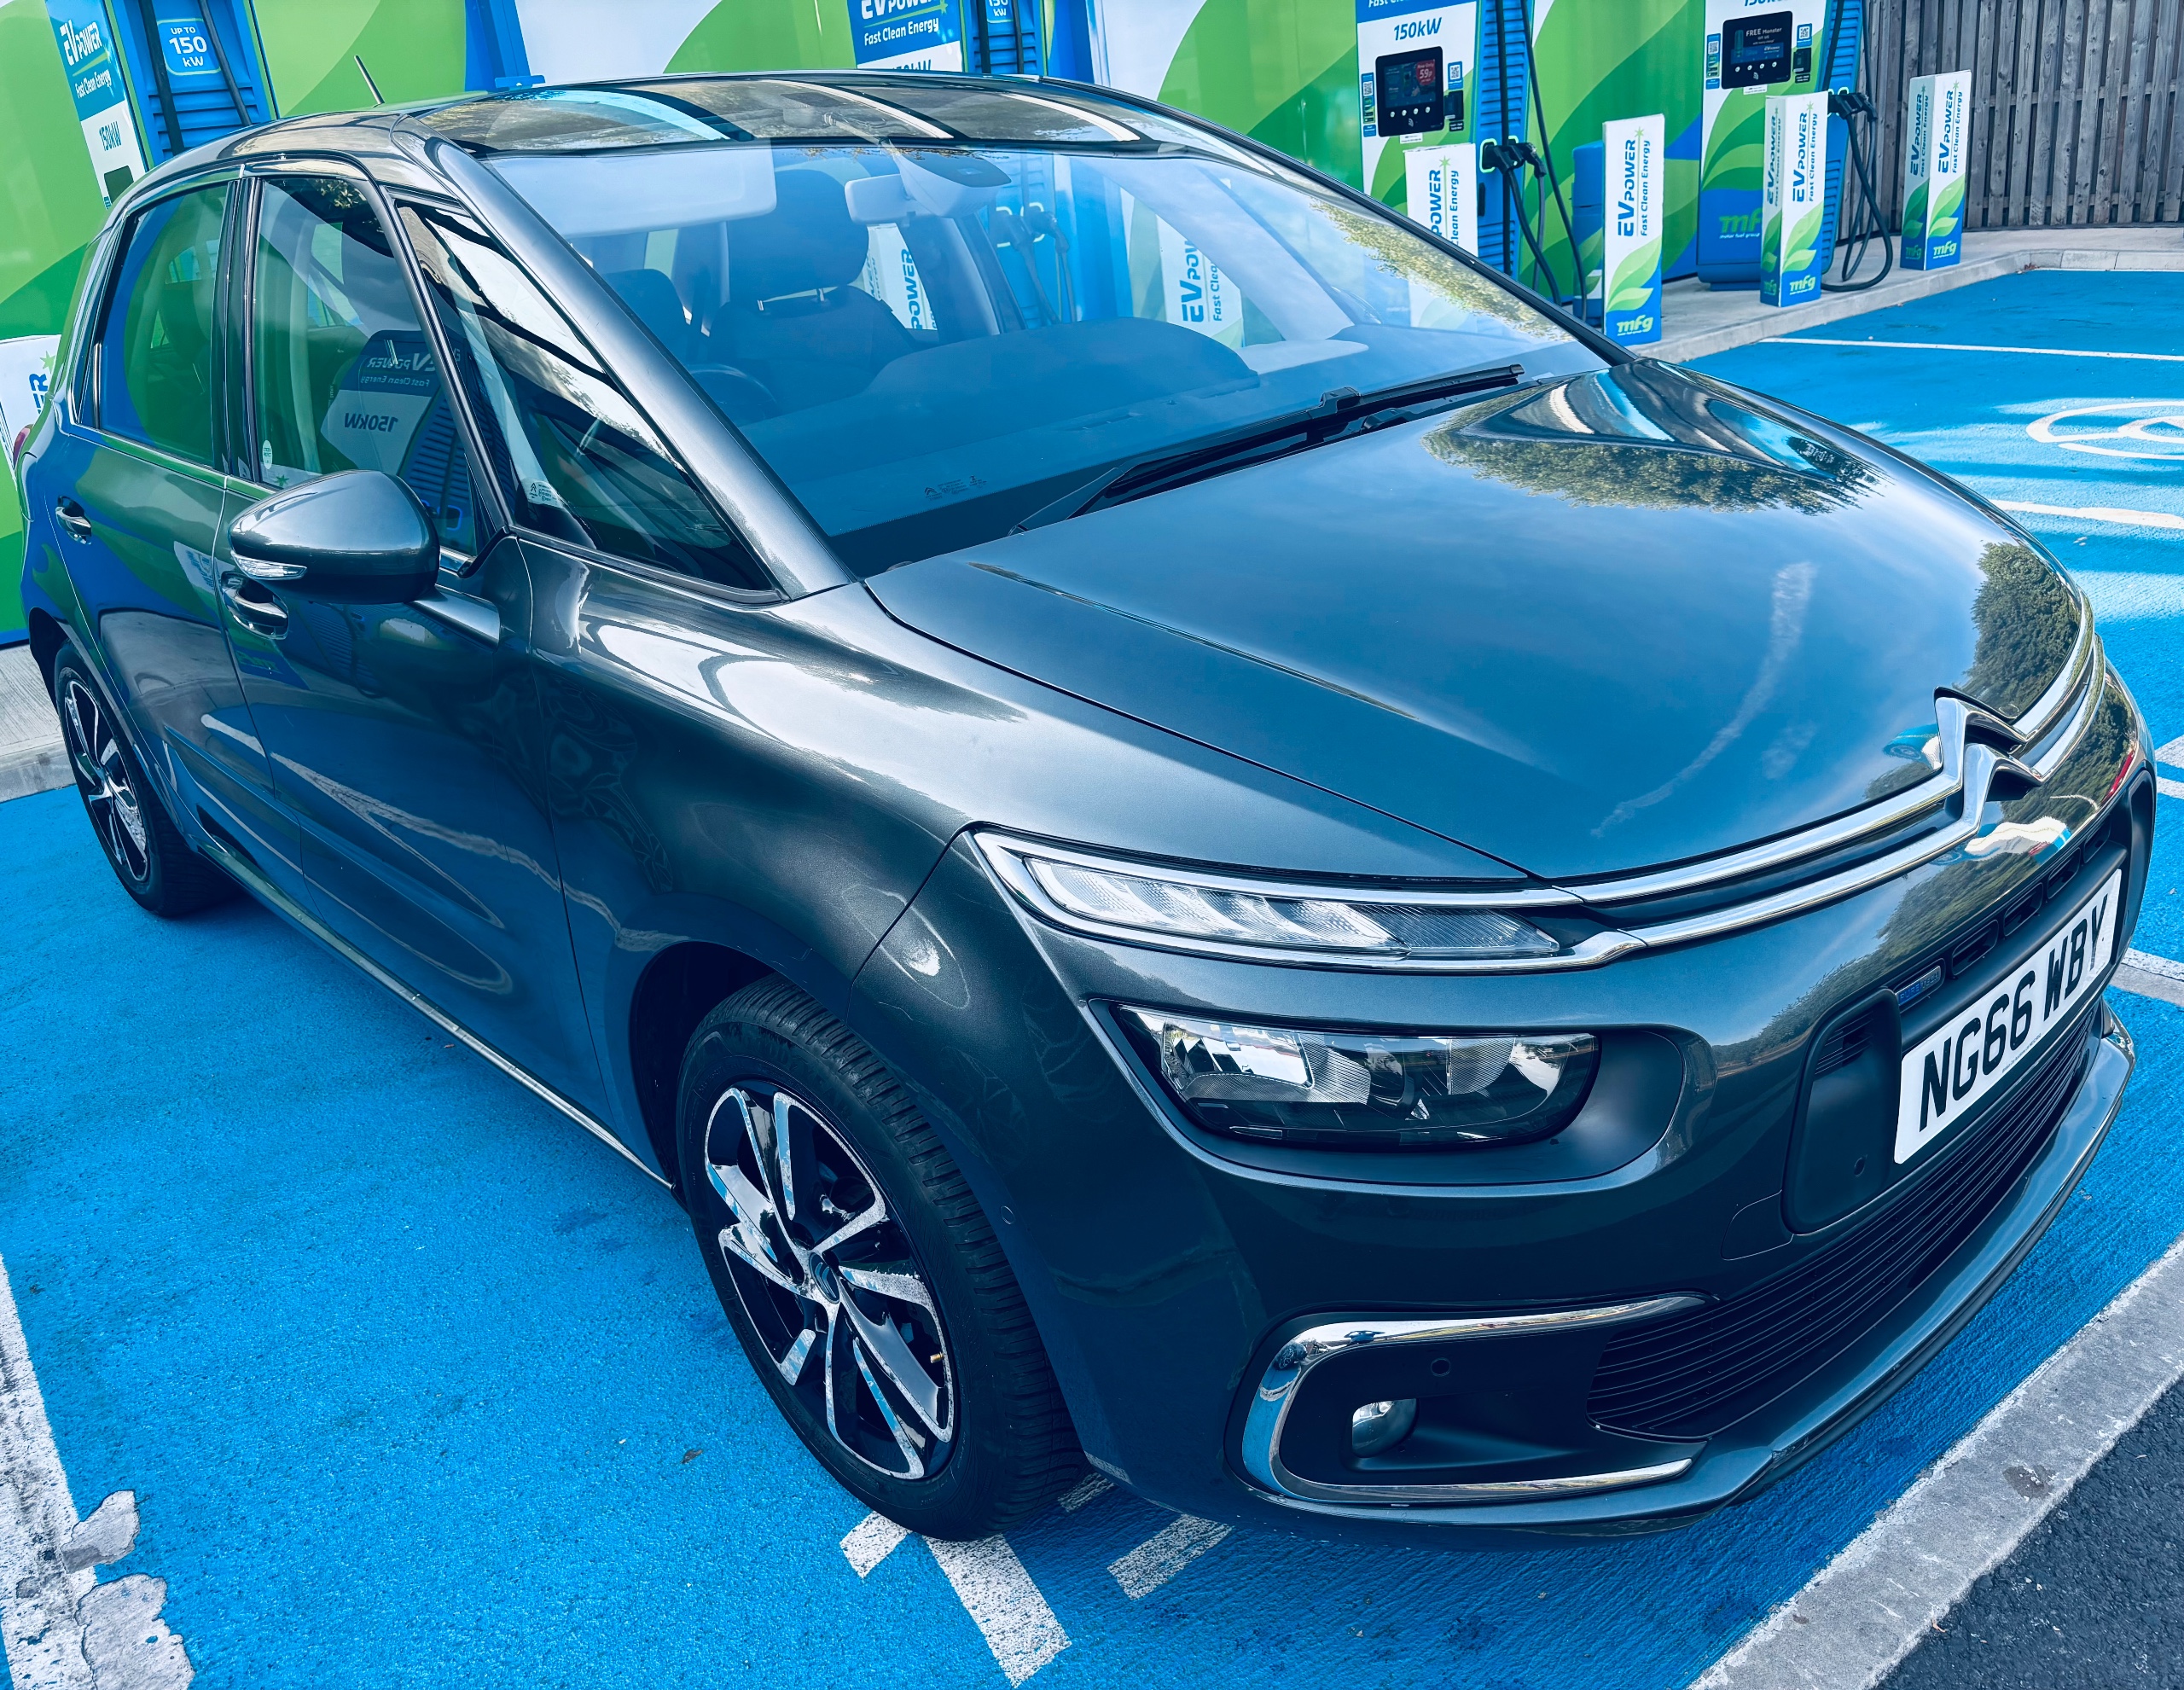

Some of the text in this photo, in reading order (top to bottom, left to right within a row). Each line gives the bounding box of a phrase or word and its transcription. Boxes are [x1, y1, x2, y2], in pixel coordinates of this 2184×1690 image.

[993, 8, 1007, 16] kW
[864, 18, 939, 46] Fast Clean Energy
[1394, 17, 1442, 40] 150kW
[1745, 28, 1762, 37] FREE
[169, 36, 207, 54] 150
[183, 56, 204, 67] kW
[99, 121, 122, 151] 150kW
[1449, 170, 1460, 212] Energy
[1719, 207, 1763, 233] mf
[1933, 241, 1958, 256] mfg
[1211, 264, 1222, 322] Fast Clea
[1790, 274, 1816, 291] mfg
[1617, 314, 1653, 333] mfg
[1920, 893, 2109, 1133] NG66 WBY
